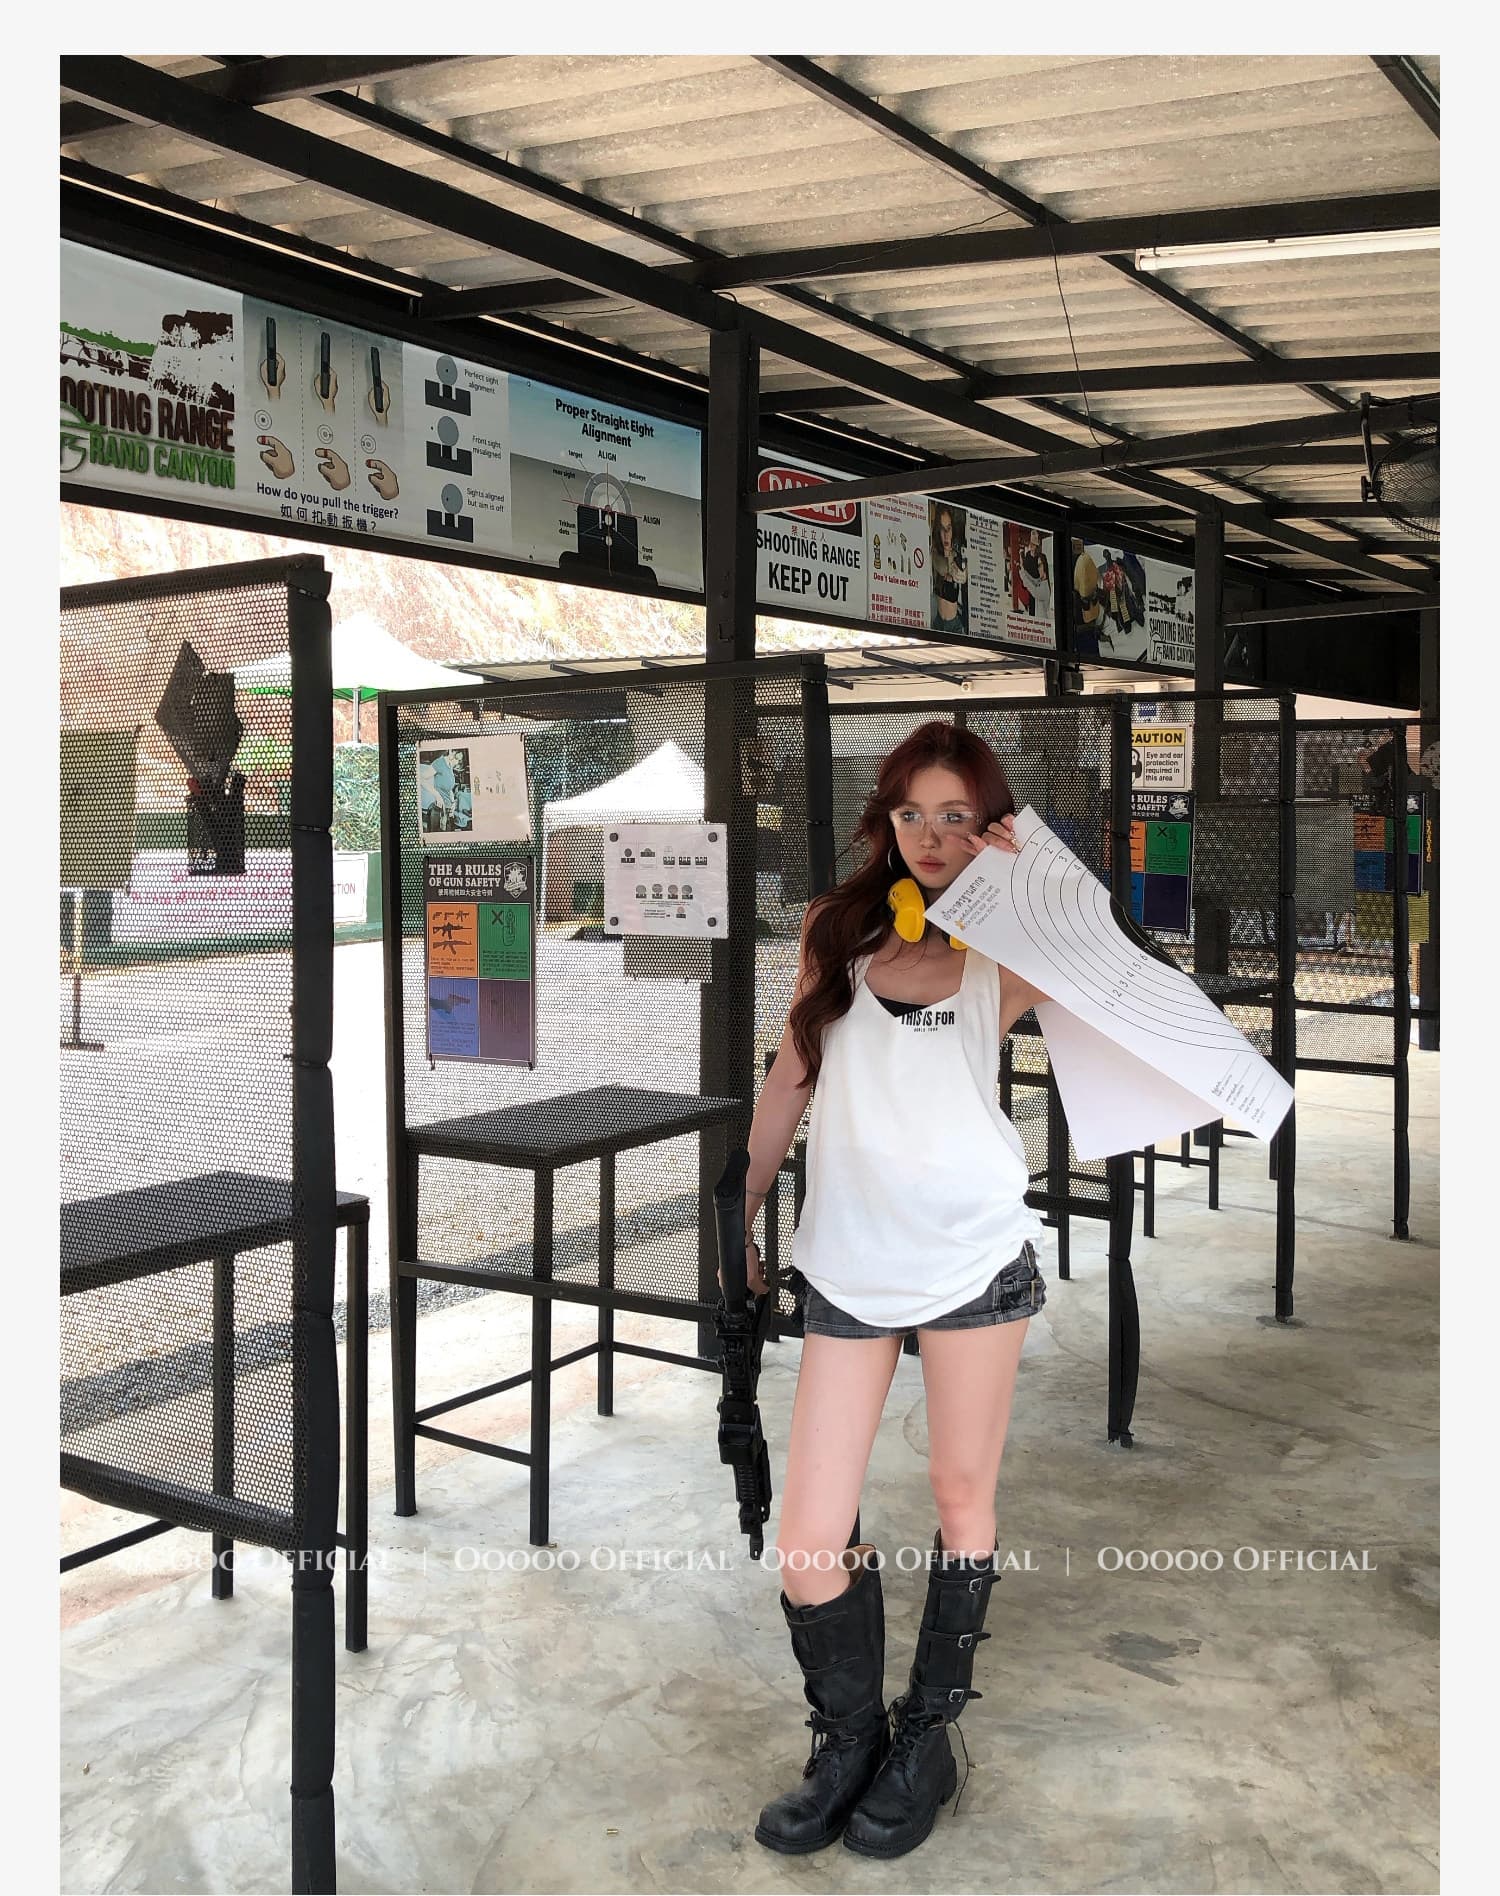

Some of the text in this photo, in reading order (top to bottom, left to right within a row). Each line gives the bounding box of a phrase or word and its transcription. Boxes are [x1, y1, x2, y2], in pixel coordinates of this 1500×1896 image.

[158, 397, 235, 453] RANGE
[555, 398, 654, 438] Proper Straight Eight
[582, 422, 632, 448] Alignment
[598, 449, 617, 462] ALIGN
[154, 445, 236, 490] CANYON
[256, 481, 399, 519] How do you pull the trigger?
[643, 514, 661, 526] ALIGN
[757, 528, 861, 569] SHOOTING RANGE
[768, 561, 850, 602] KEEP OUT
[1146, 751, 1158, 760] Eye
[1160, 751, 1172, 759] and
[1145, 767, 1173, 775] required
[1136, 794, 1168, 804] RULES
[1136, 803, 1168, 812] SAFETY
[428, 863, 502, 876] THE 4 RULES
[333, 882, 356, 896] TION
[428, 877, 501, 887] OF GUN SAFETY
[1112, 989, 1122, 998] 2
[1119, 979, 1129, 988] 3
[1126, 970, 1135, 978] 4
[1132, 961, 1142, 970] 5
[922, 1010, 933, 1026] IS
[935, 1010, 955, 1026] FOR
